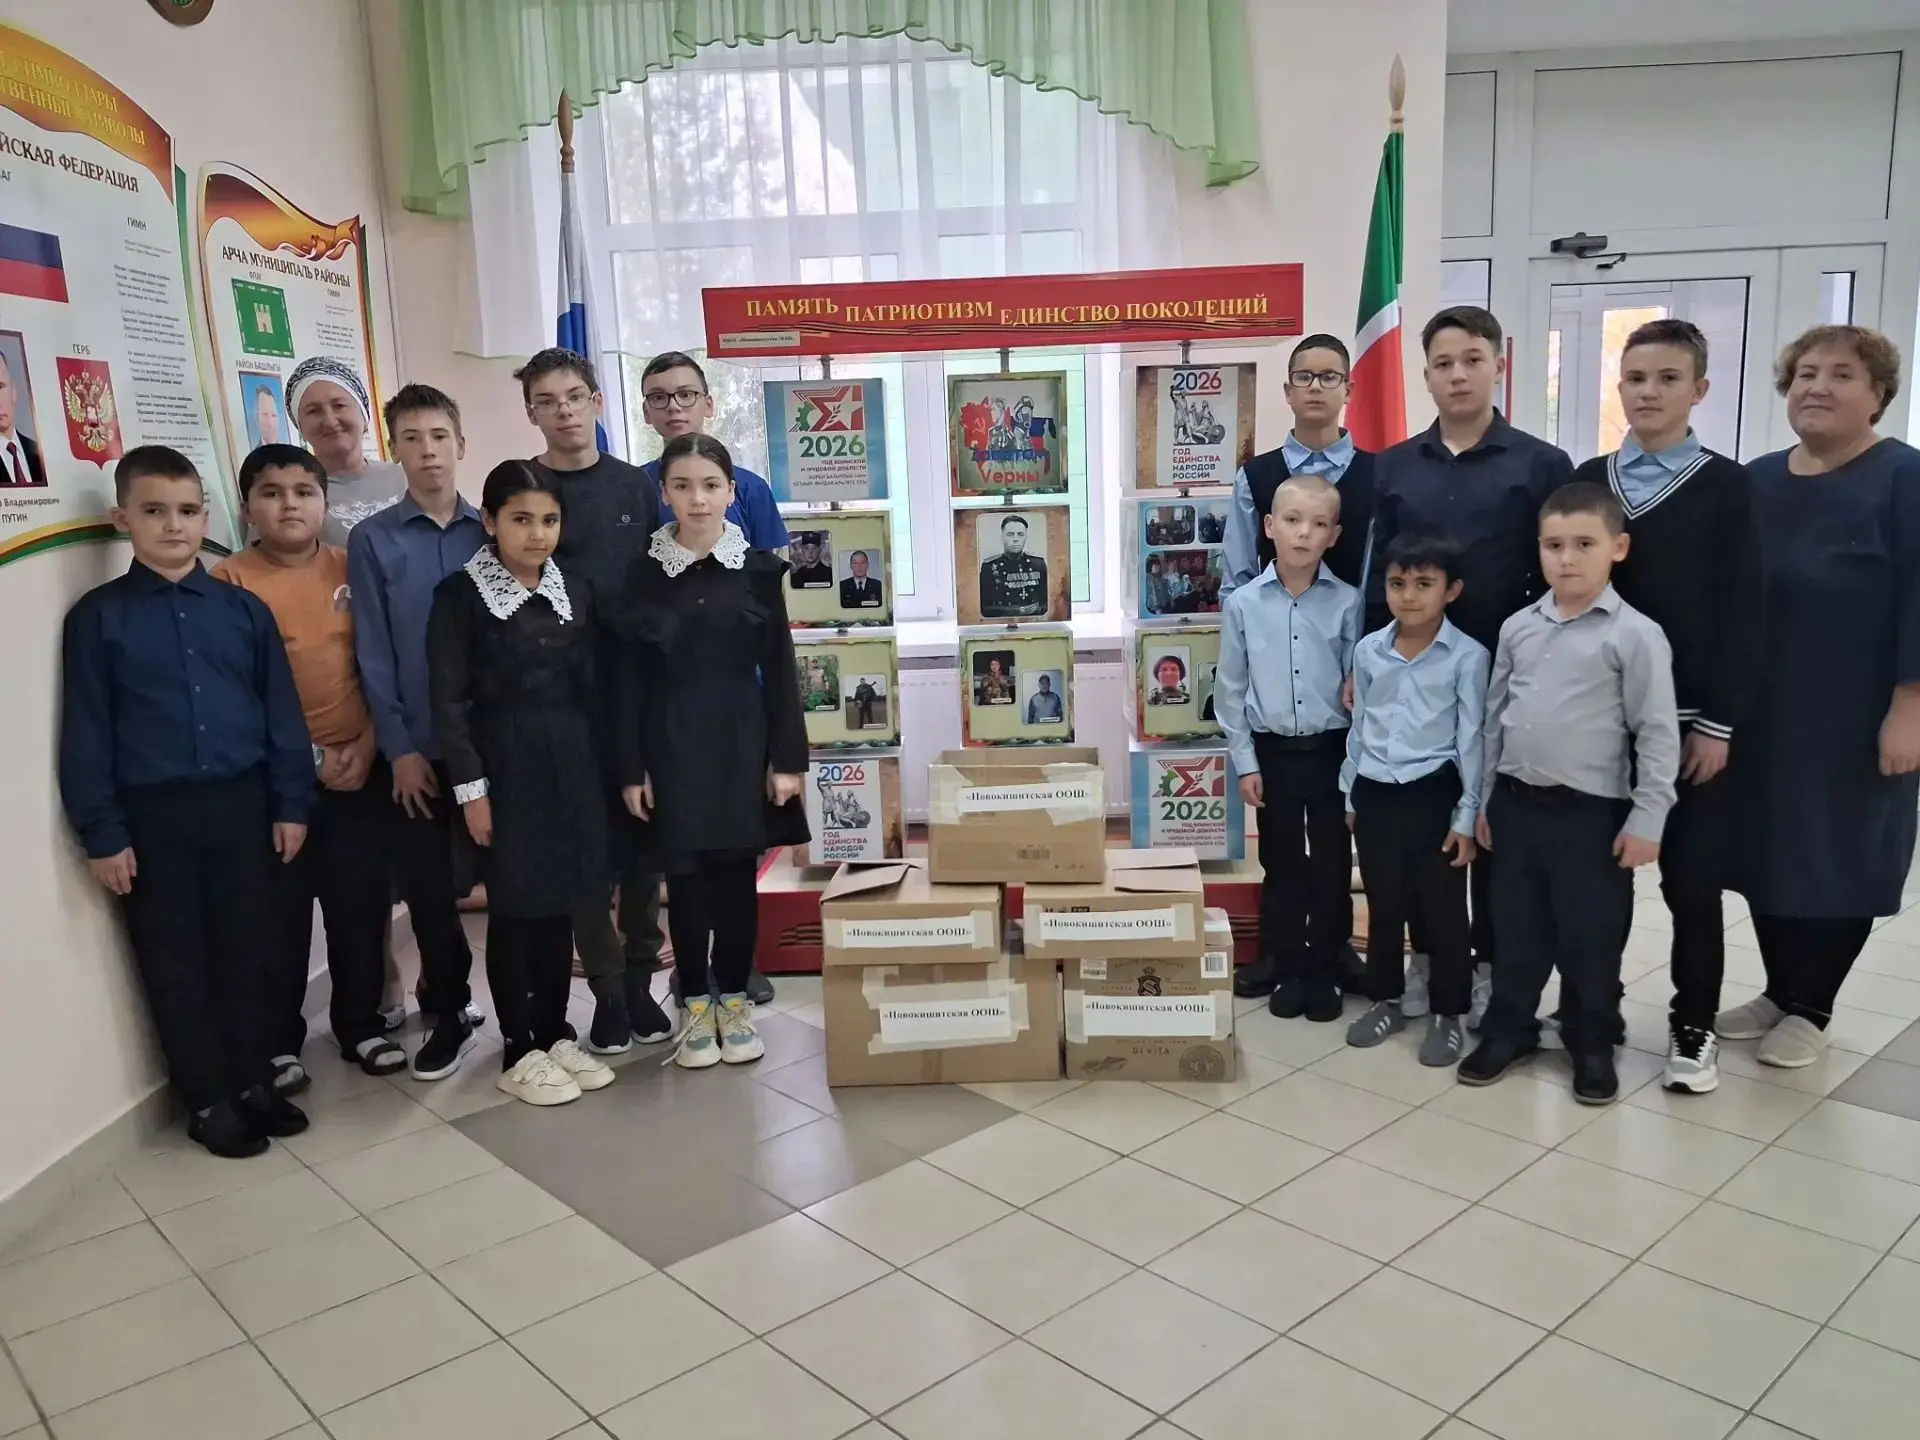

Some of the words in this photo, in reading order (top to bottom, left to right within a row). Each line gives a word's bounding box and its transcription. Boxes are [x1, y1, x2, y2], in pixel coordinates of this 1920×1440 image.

[59, 153, 140, 193] ФЕДЕРАЦИЯ
[127, 217, 147, 230] ГИМН
[222, 246, 250, 265] АРЧА
[249, 251, 313, 280] МУНИЦИПАЛЬ
[314, 266, 351, 288] РАЙОНЫ
[746, 298, 839, 317] ПАМЯТЬ
[846, 301, 993, 322] ПАТРИОТИЗМ
[1000, 304, 1120, 327] ЕДИНСТВО
[1126, 293, 1268, 320] ПОКОЛЕНИЙ
[73, 344, 91, 355] ГЕРБ
[1173, 371, 1222, 391] 2026
[799, 435, 865, 457] 2026
[4, 497, 60, 509] Владимирович
[2, 513, 28, 523] ПУТИН
[819, 764, 865, 781] 2026
[966, 791, 1053, 801] «Новокишитская
[1161, 800, 1226, 820] 2026
[1044, 918, 1133, 928] «Новокишитская
[1136, 918, 1172, 928] ООШ»
[846, 928, 934, 937] «Новокишитская
[936, 927, 972, 936] ООШ»
[1086, 1001, 1172, 1012] «Новокишитская
[1175, 1002, 1210, 1013] ООШ»
[883, 1010, 969, 1020] «Новокишитская
[970, 1008, 1006, 1017] ООШ»
